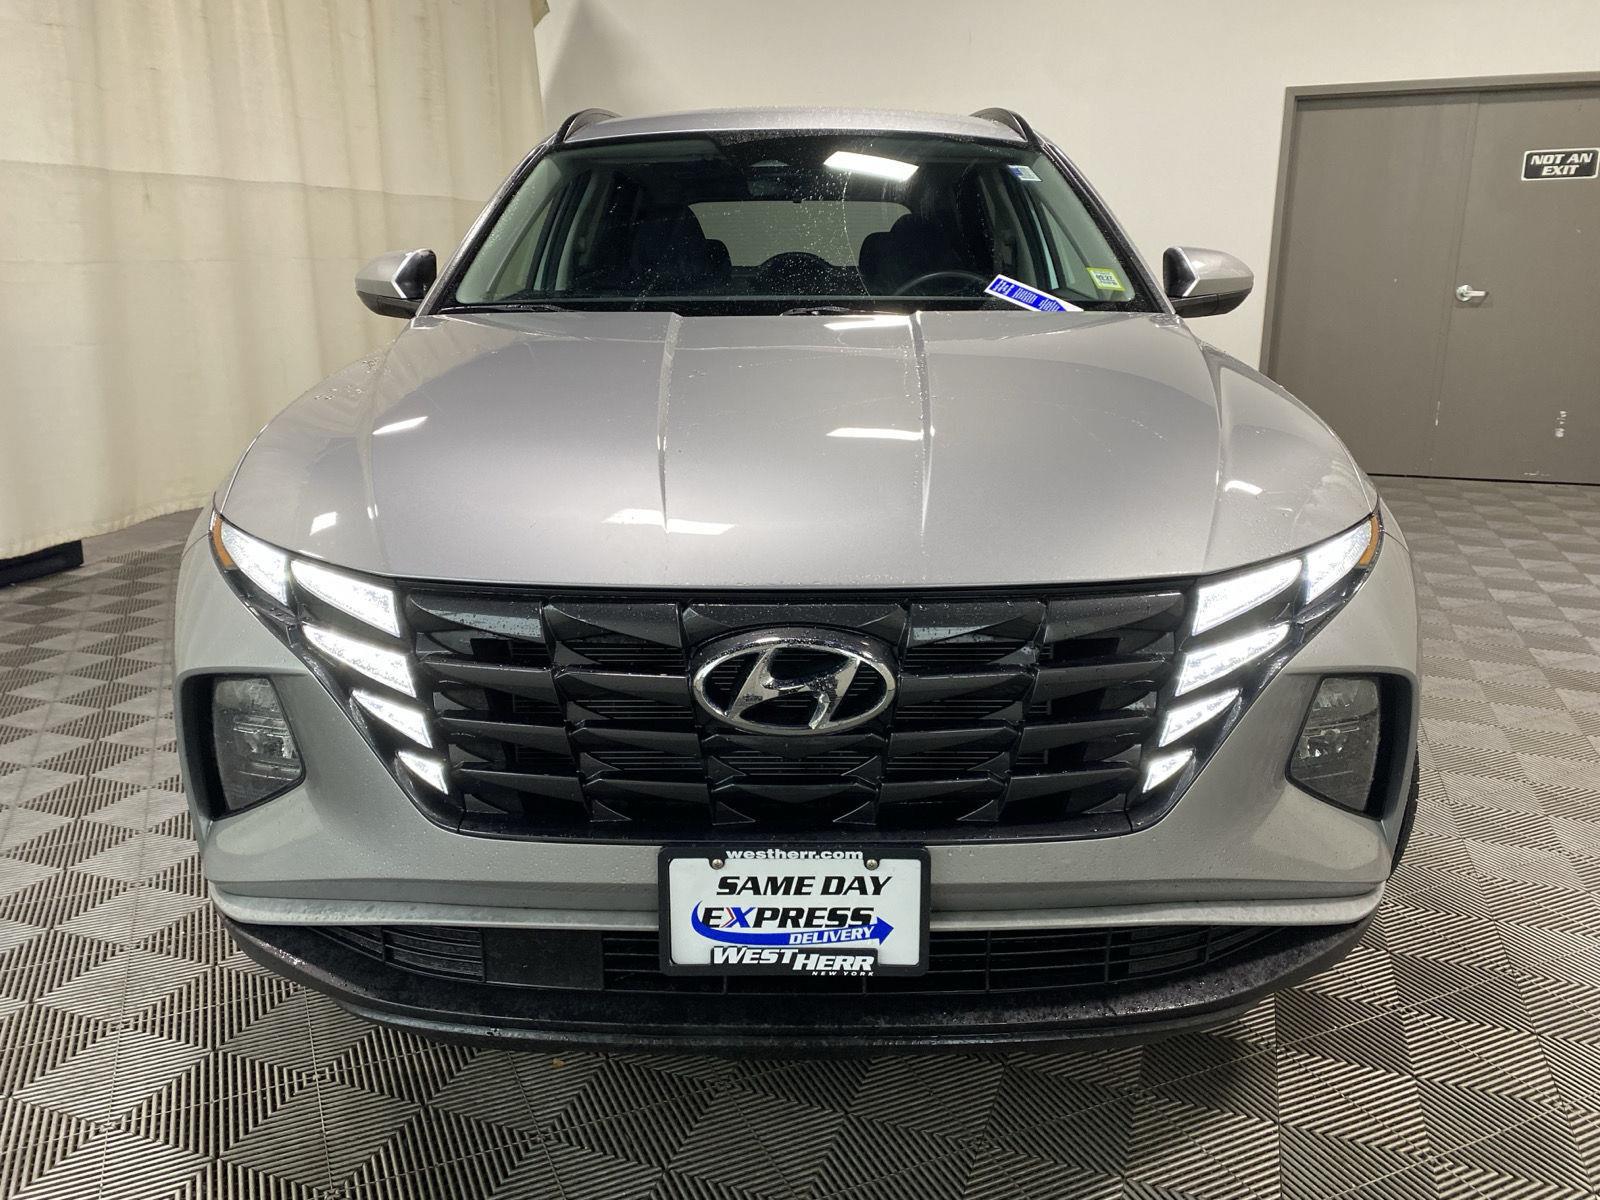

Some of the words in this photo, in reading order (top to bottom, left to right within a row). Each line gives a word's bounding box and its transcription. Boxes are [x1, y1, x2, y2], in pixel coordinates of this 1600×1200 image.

[1530, 154, 1565, 165] NOT
[1567, 153, 1593, 164] AN
[1541, 165, 1580, 176] EXIT
[726, 849, 864, 859] westherr.com
[716, 876, 816, 896] SAME
[820, 876, 893, 896] DAY
[702, 906, 874, 928] EXPRESS
[788, 926, 874, 945] DELIVERY
